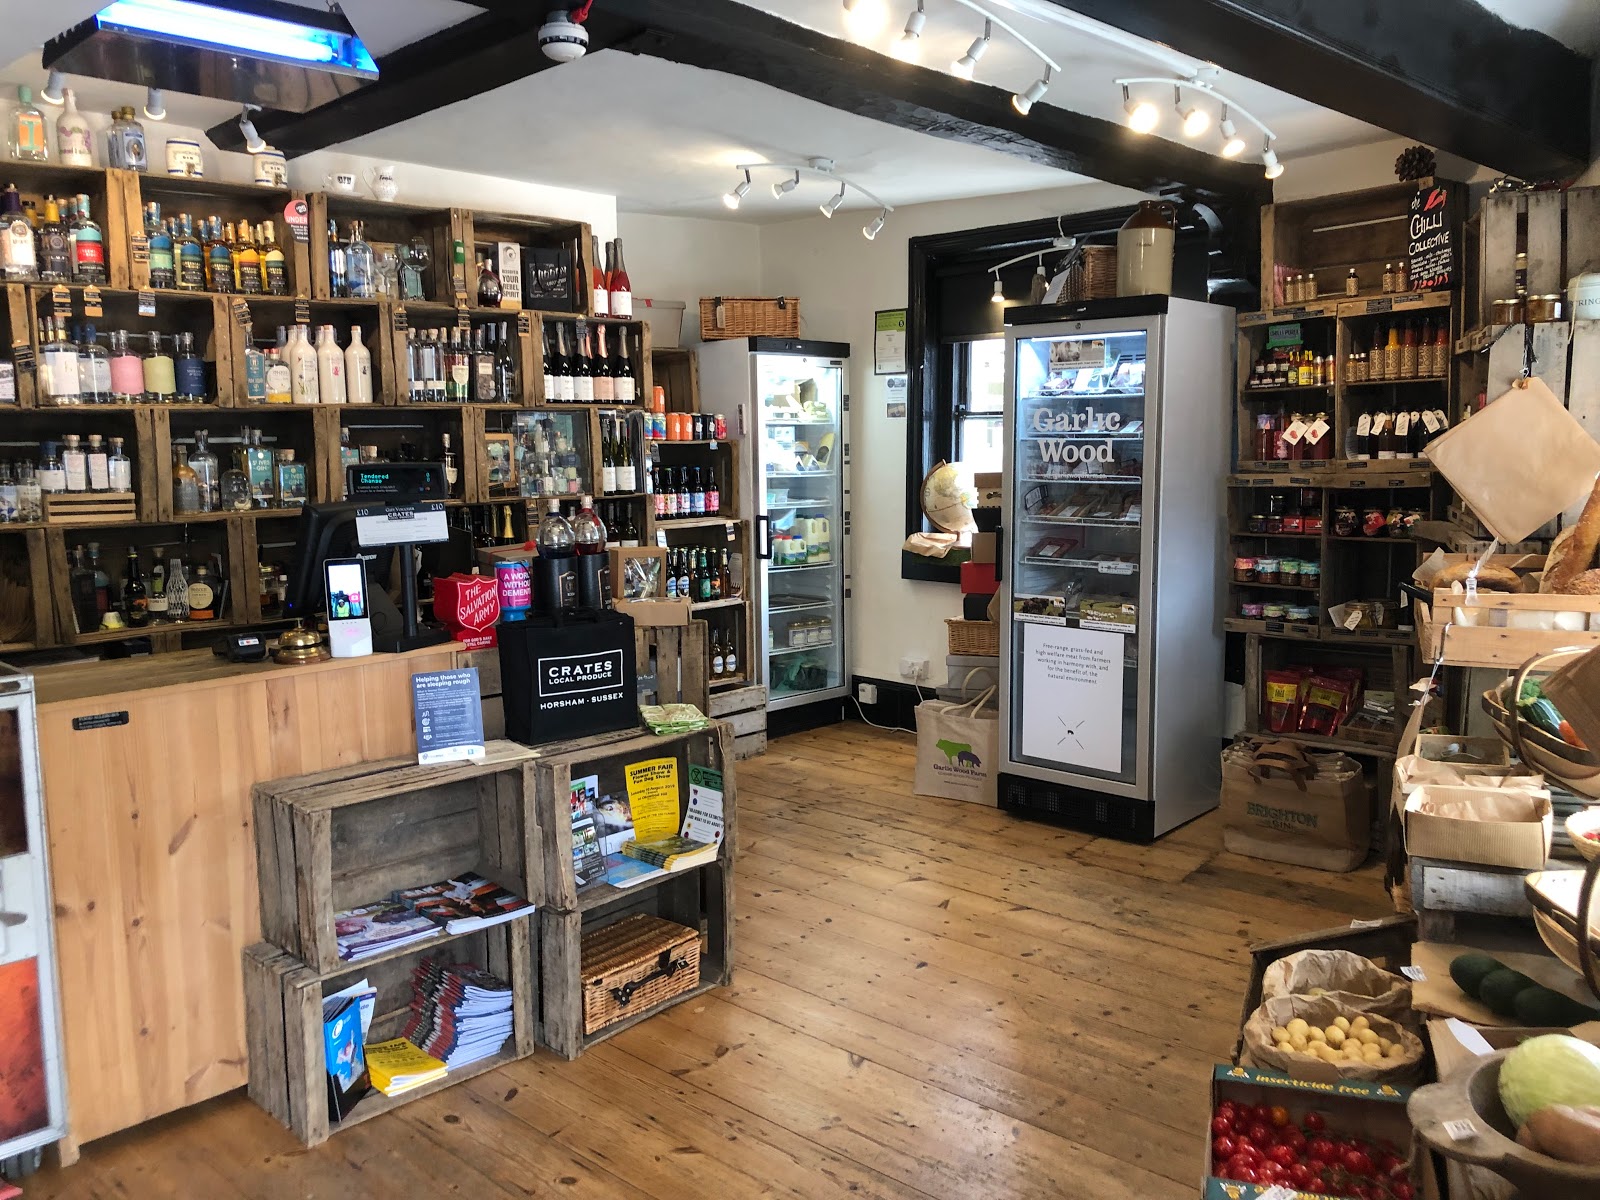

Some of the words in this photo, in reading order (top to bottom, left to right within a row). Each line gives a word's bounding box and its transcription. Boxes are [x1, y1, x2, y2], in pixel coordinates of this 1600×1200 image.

[1408, 230, 1450, 256] COLLECTIVE
[1033, 406, 1120, 432] Garlic
[1037, 439, 1115, 462] Wood
[465, 584, 481, 600] THE
[502, 588, 531, 596] DEMENT
[504, 580, 530, 589] WITHOU
[460, 584, 497, 620] SALVATION
[473, 600, 495, 626] ARMY
[548, 661, 613, 678] CRATES
[549, 677, 574, 685] LOCAL
[576, 672, 612, 681] PRODUCE
[540, 698, 584, 710] HORSHAM
[591, 692, 624, 703] SUSSEX
[630, 766, 656, 777] SUMMER
[933, 764, 952, 772] Garlic
[953, 766, 970, 774] Wood
[970, 769, 987, 778] Farm
[1246, 802, 1318, 828] BRIGHTON
[1272, 820, 1291, 830] GIN
[1256, 1074, 1334, 1090] insecticide
[1339, 1085, 1370, 1095] free
